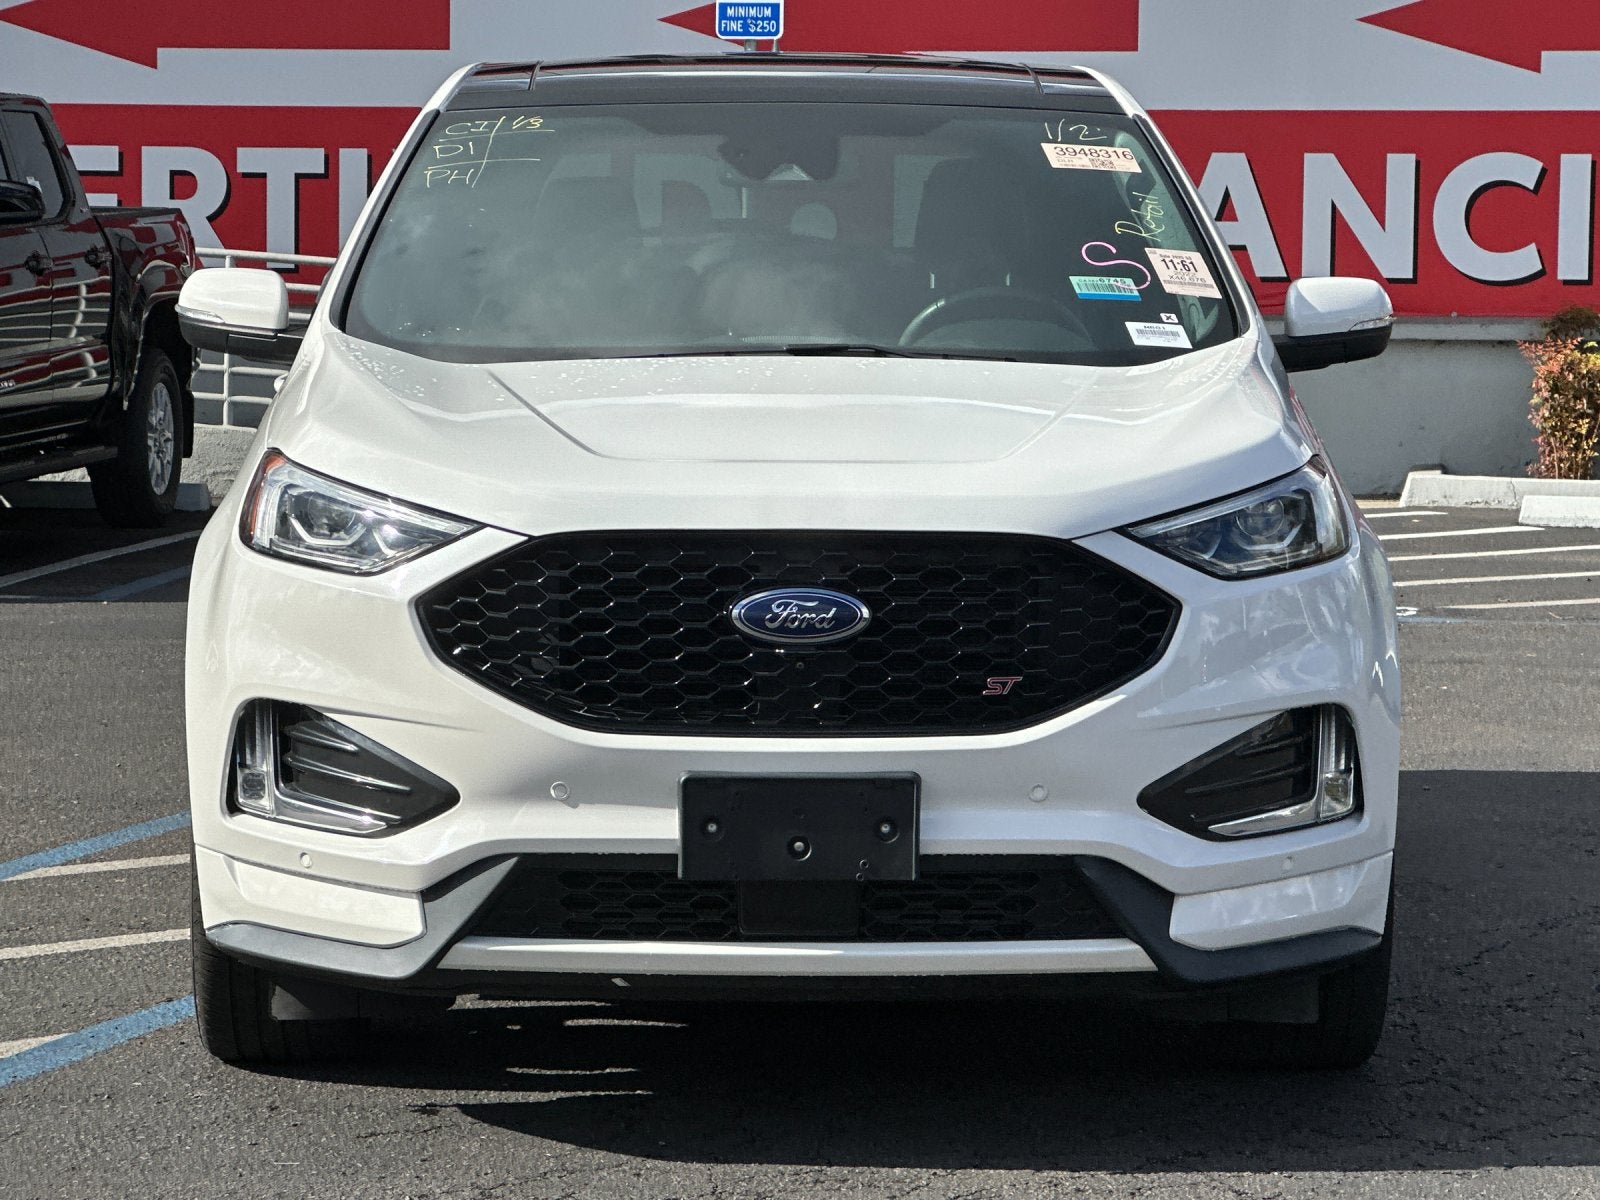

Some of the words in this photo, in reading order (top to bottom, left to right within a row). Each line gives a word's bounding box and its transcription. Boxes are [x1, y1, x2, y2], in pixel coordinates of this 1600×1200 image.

[727, 6, 772, 18] MINIMUM
[721, 20, 744, 32] FINE
[747, 19, 777, 33] $250
[1053, 146, 1135, 161] 3948316
[1161, 258, 1198, 272] 11:61
[764, 599, 838, 630] Ford
[982, 676, 1024, 696] ST
